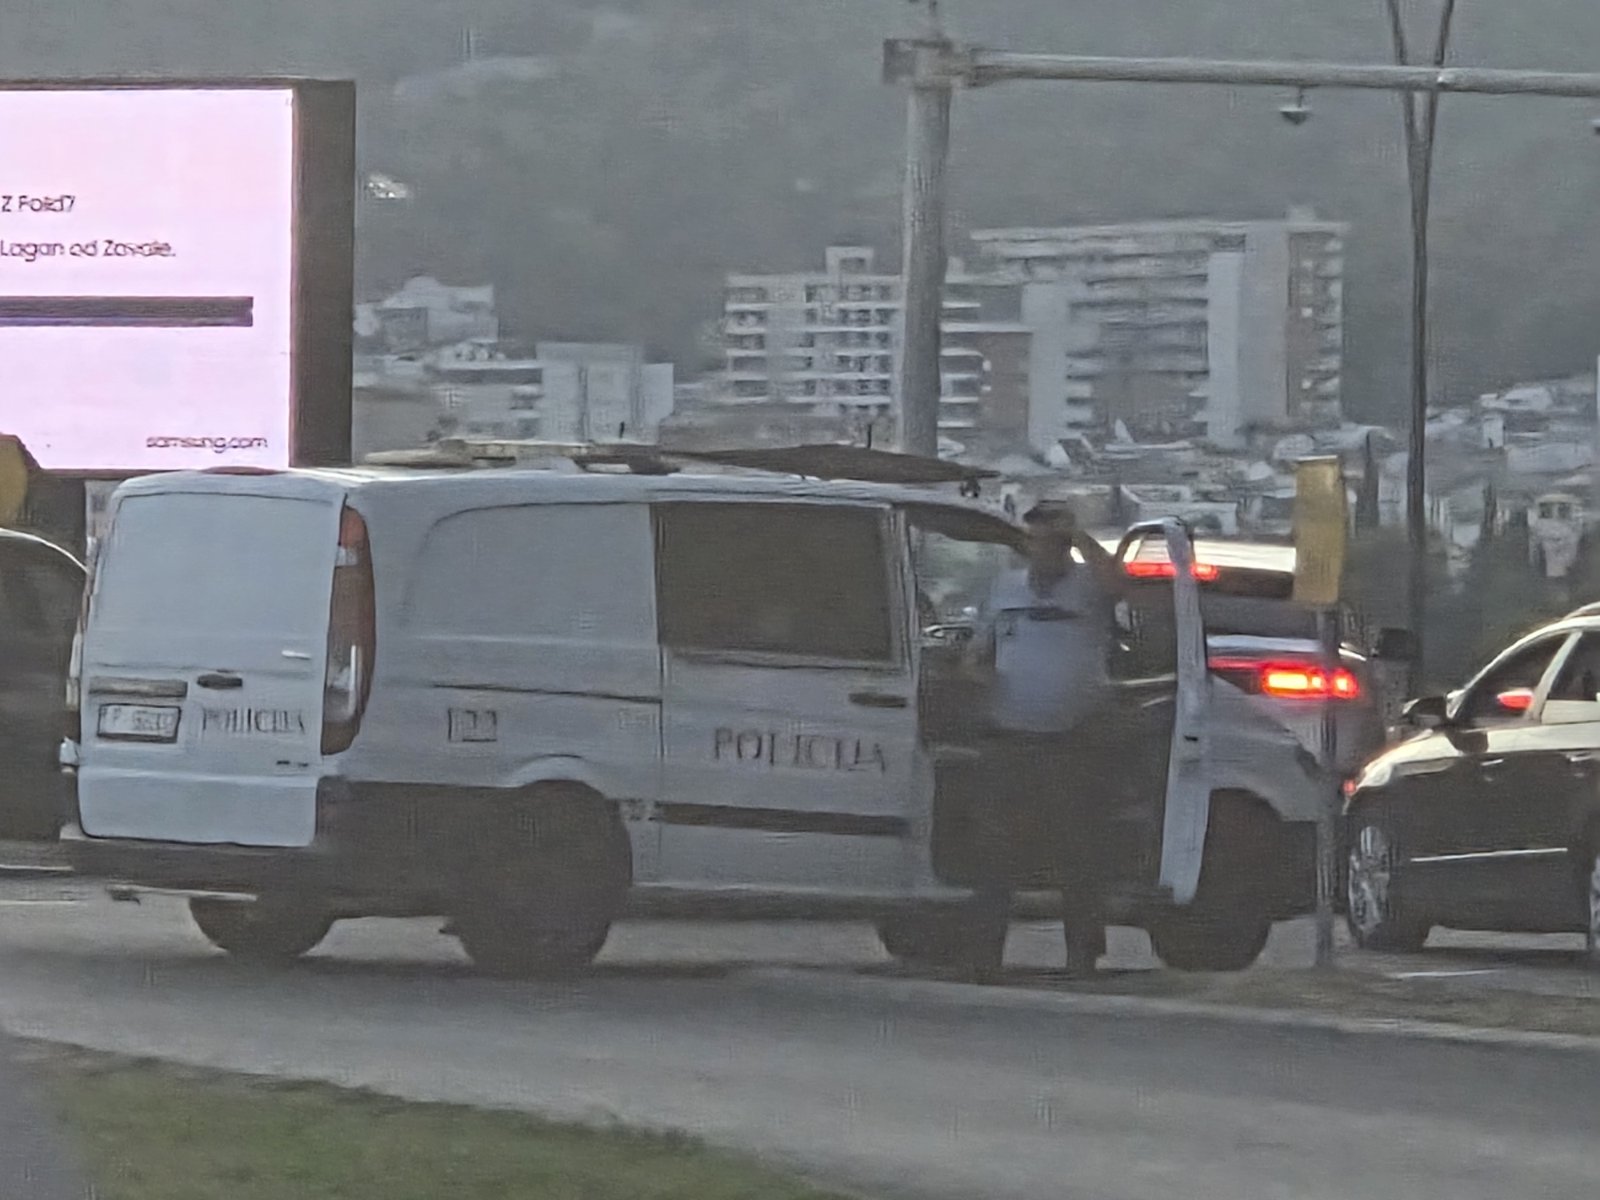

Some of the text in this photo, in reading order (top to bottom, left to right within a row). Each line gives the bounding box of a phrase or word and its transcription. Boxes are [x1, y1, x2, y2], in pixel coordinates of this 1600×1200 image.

[1, 194, 76, 212] Z Fold7
[146, 436, 268, 453] samsung.com
